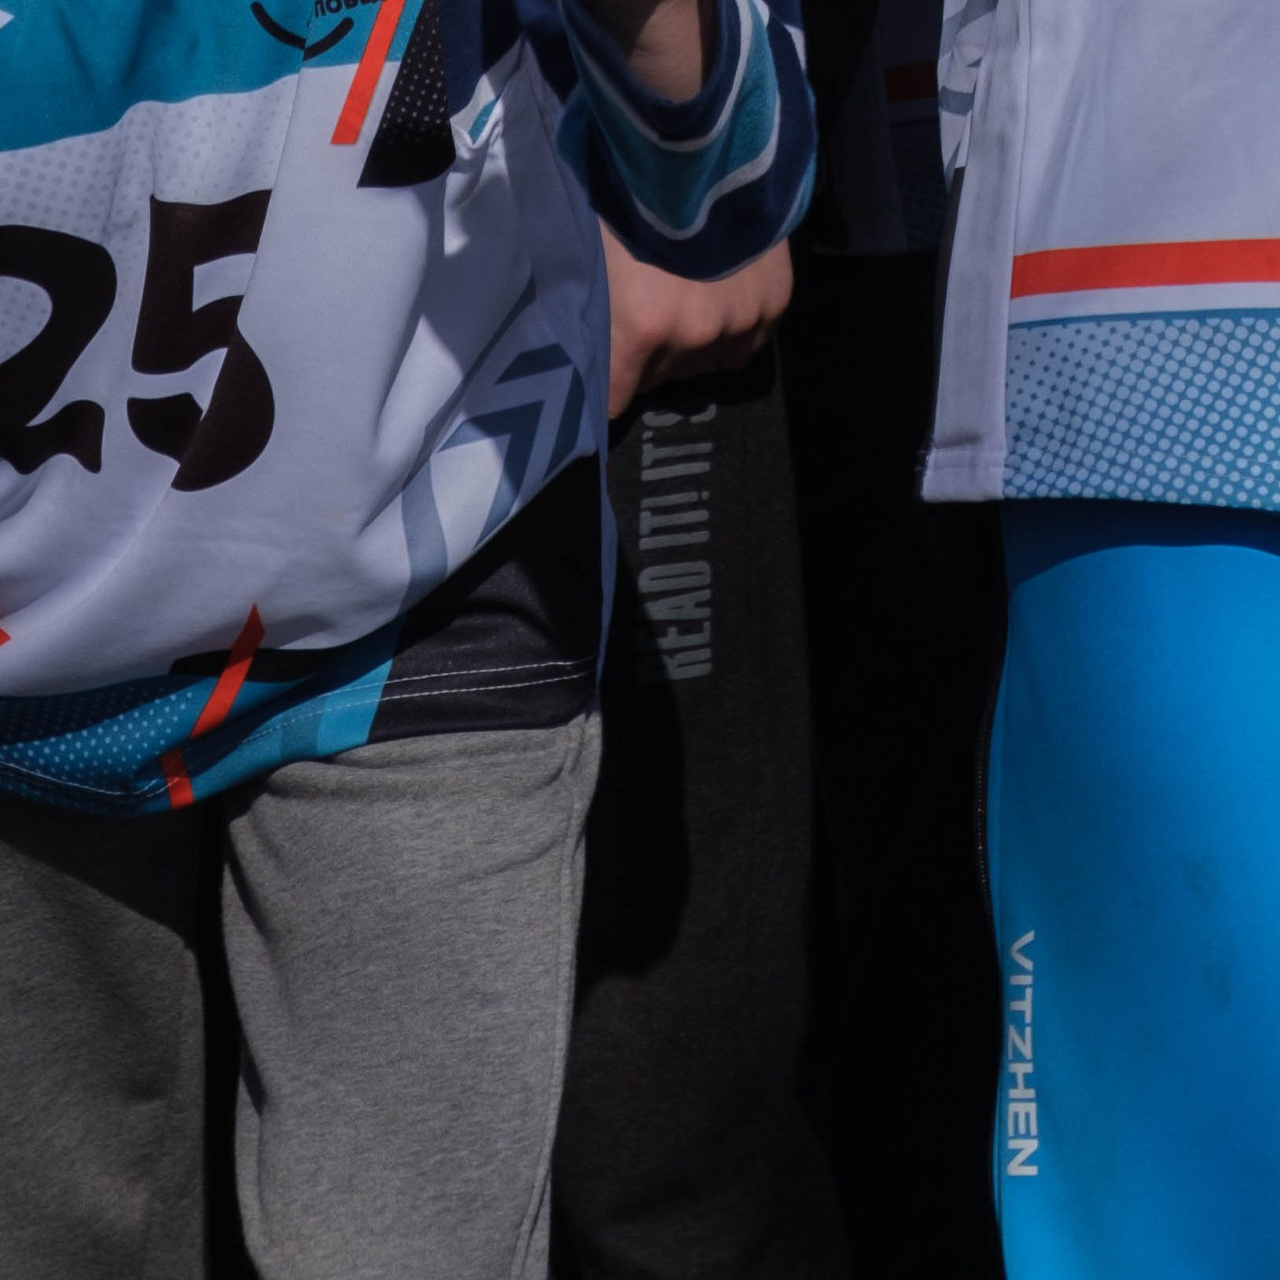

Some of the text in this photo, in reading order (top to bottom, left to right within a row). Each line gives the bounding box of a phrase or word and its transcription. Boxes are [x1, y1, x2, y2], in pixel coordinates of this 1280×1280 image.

[0, 189, 275, 492] 25
[634, 560, 713, 686] READ
[1006, 930, 1039, 1176] VITZHEN
